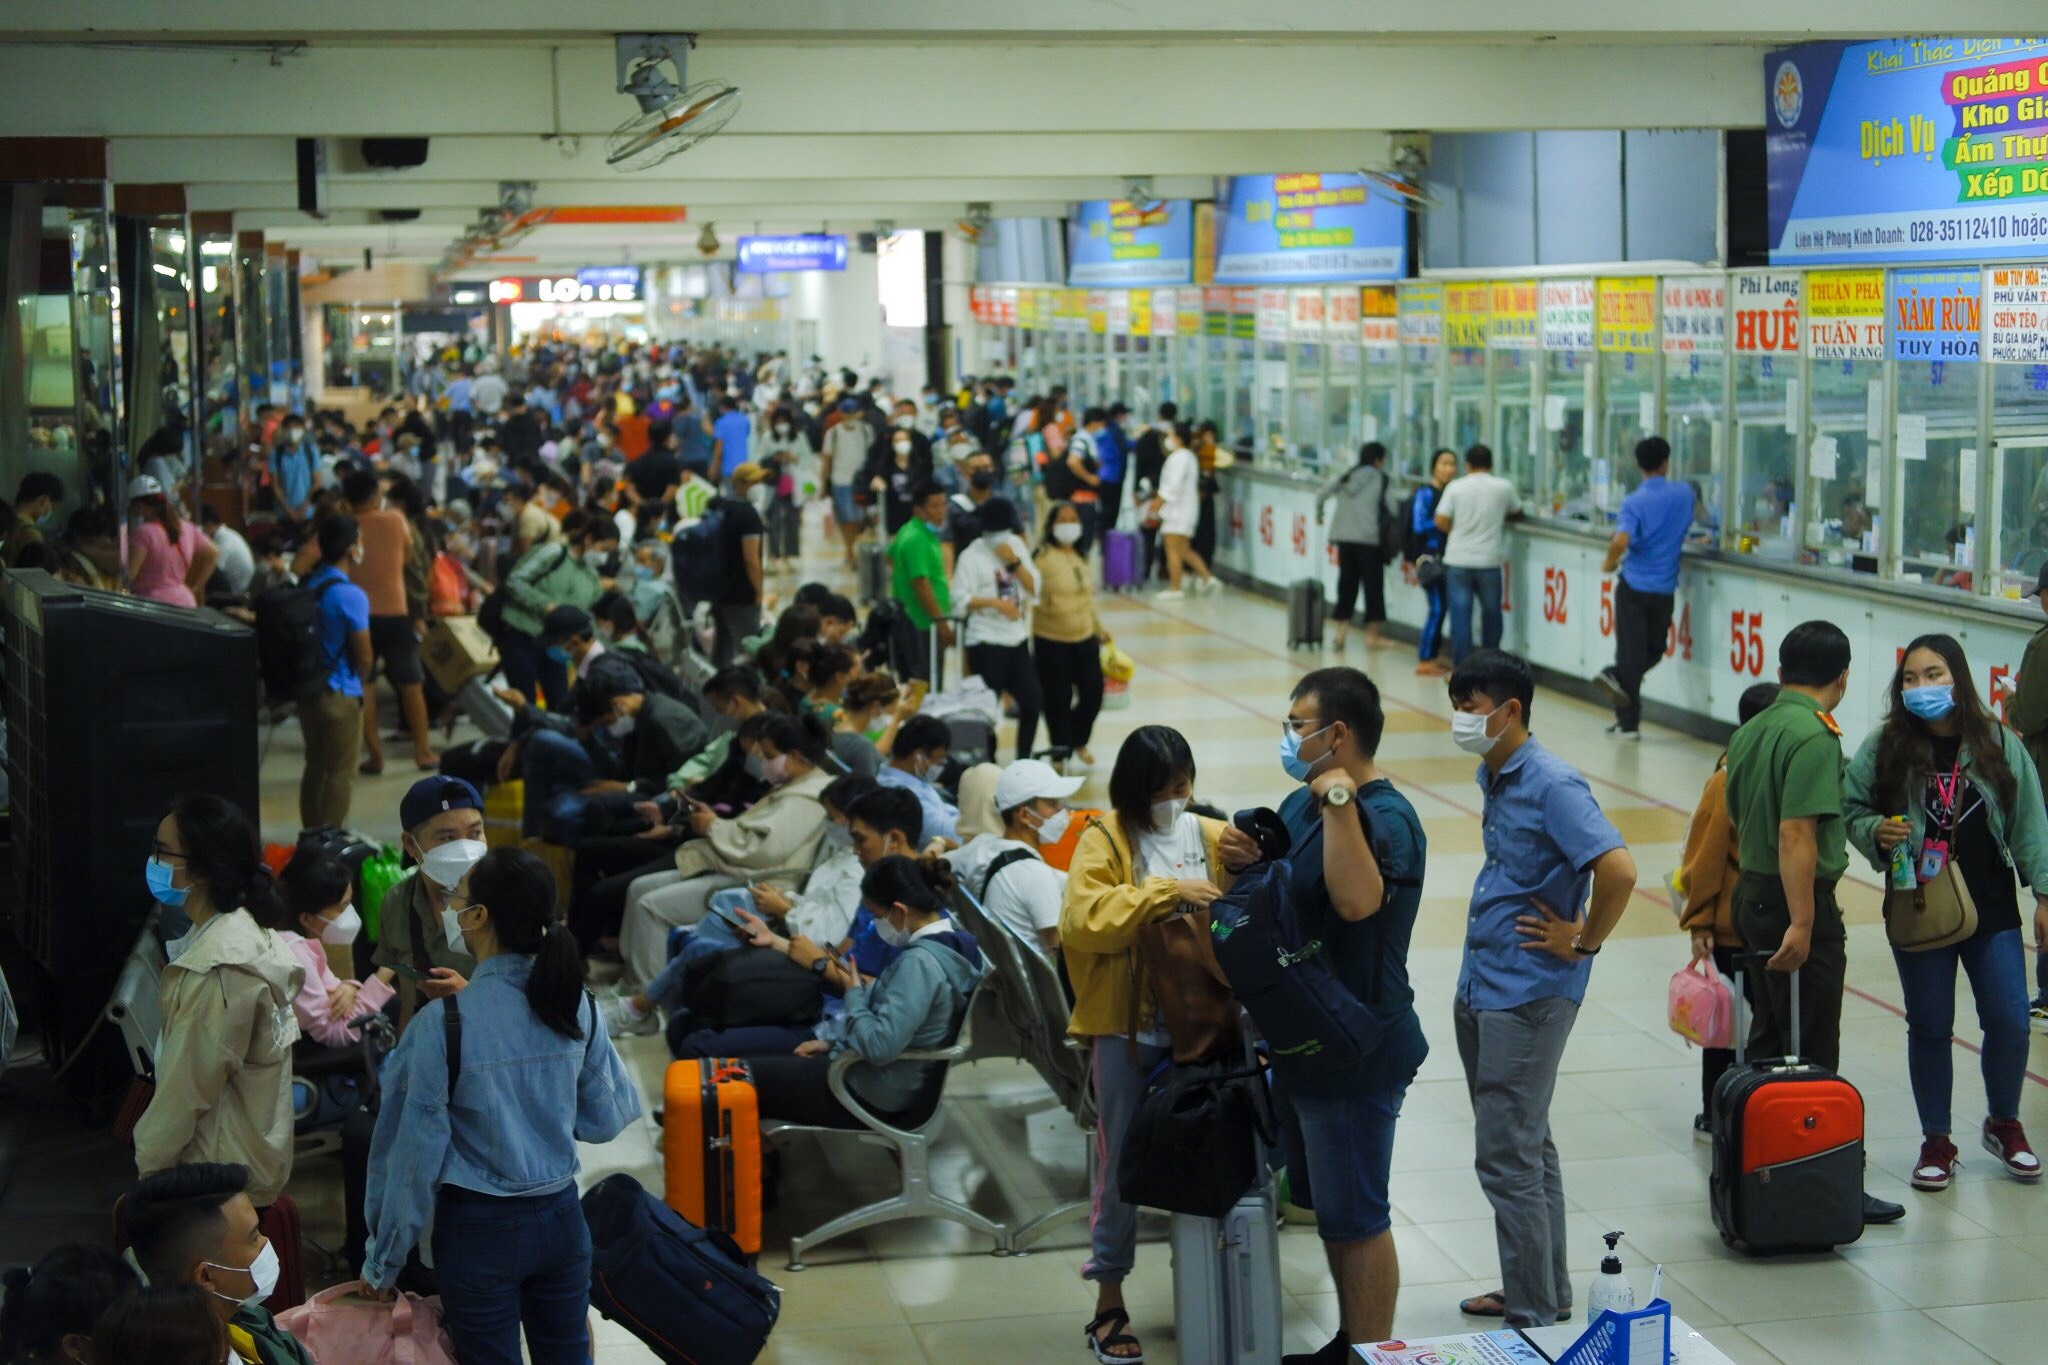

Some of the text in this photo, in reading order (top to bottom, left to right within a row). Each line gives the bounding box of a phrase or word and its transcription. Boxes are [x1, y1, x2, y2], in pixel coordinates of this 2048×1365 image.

[1867, 48, 1903, 71] Khai
[1911, 38, 1953, 64] Thác
[1952, 68, 2031, 100] Quảng
[1962, 104, 2009, 129] Kho
[1860, 116, 1904, 167] Dịch
[1909, 114, 1935, 162] Vụ
[1966, 168, 2013, 198] Xếp
[1854, 227, 1873, 245] Kinh
[1910, 215, 2007, 243] 028-35112410
[2012, 212, 2048, 242] hoặc
[1740, 275, 1798, 297] Phi Long
[1897, 287, 1935, 332] NĂM
[1849, 346, 1882, 358] RANG
[1897, 336, 1979, 356] TUY HÒA
[2006, 332, 2019, 345] GIA
[1544, 566, 1568, 625] 52
[1730, 608, 1764, 677] 55
